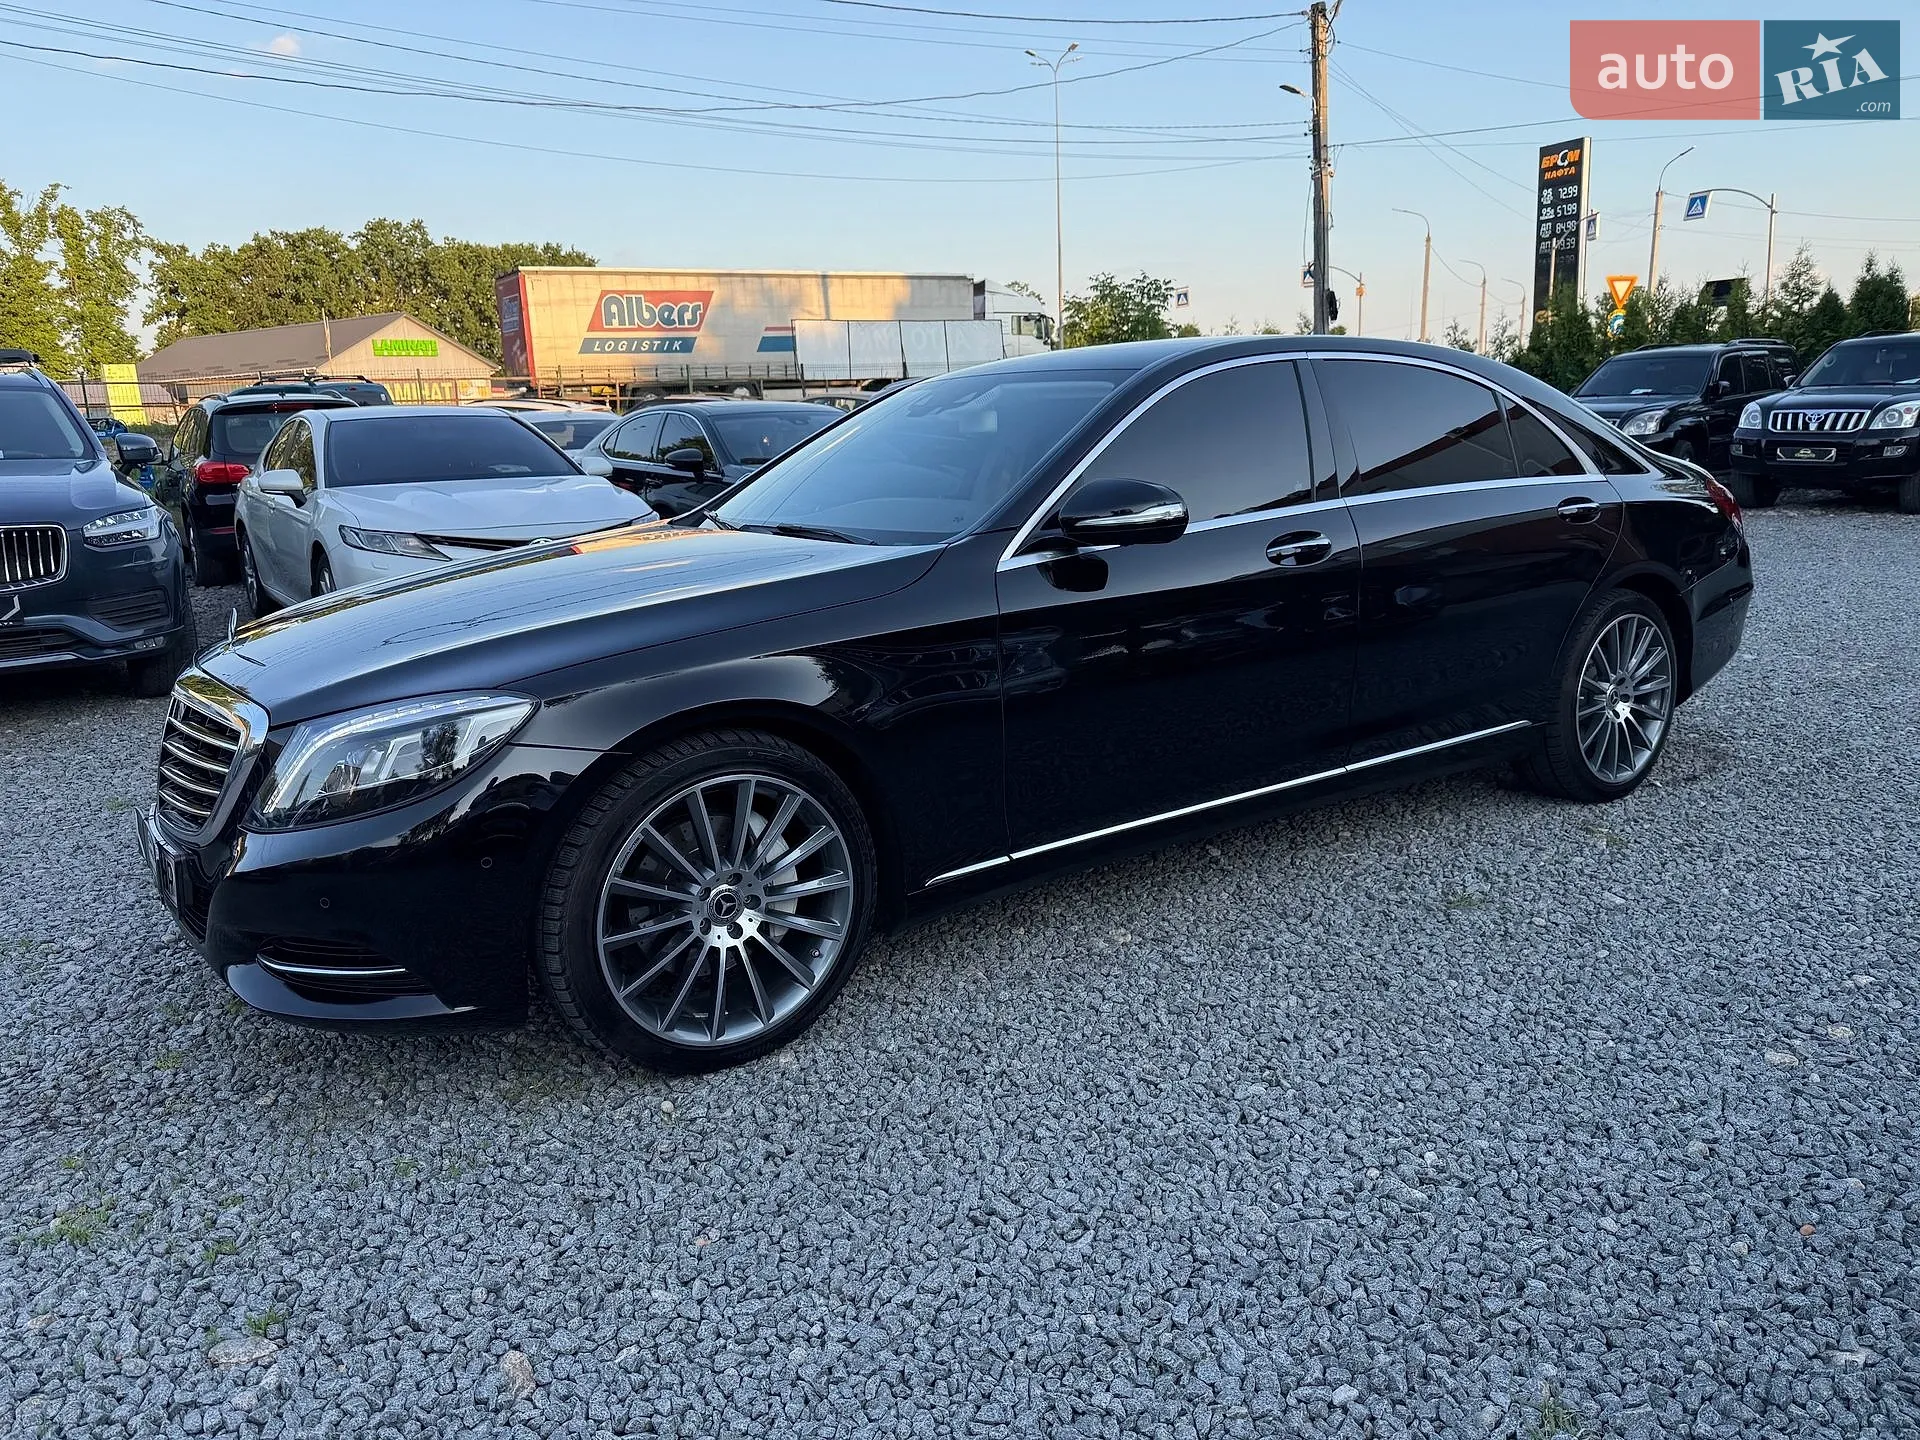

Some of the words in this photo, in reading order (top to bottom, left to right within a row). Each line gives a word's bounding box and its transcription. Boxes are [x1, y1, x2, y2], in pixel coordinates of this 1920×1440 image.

[1541, 149, 1581, 169] БРСМ
[1544, 167, 1576, 180] НАФТА
[601, 293, 704, 329] Albers
[594, 340, 683, 352] LOGISTIK
